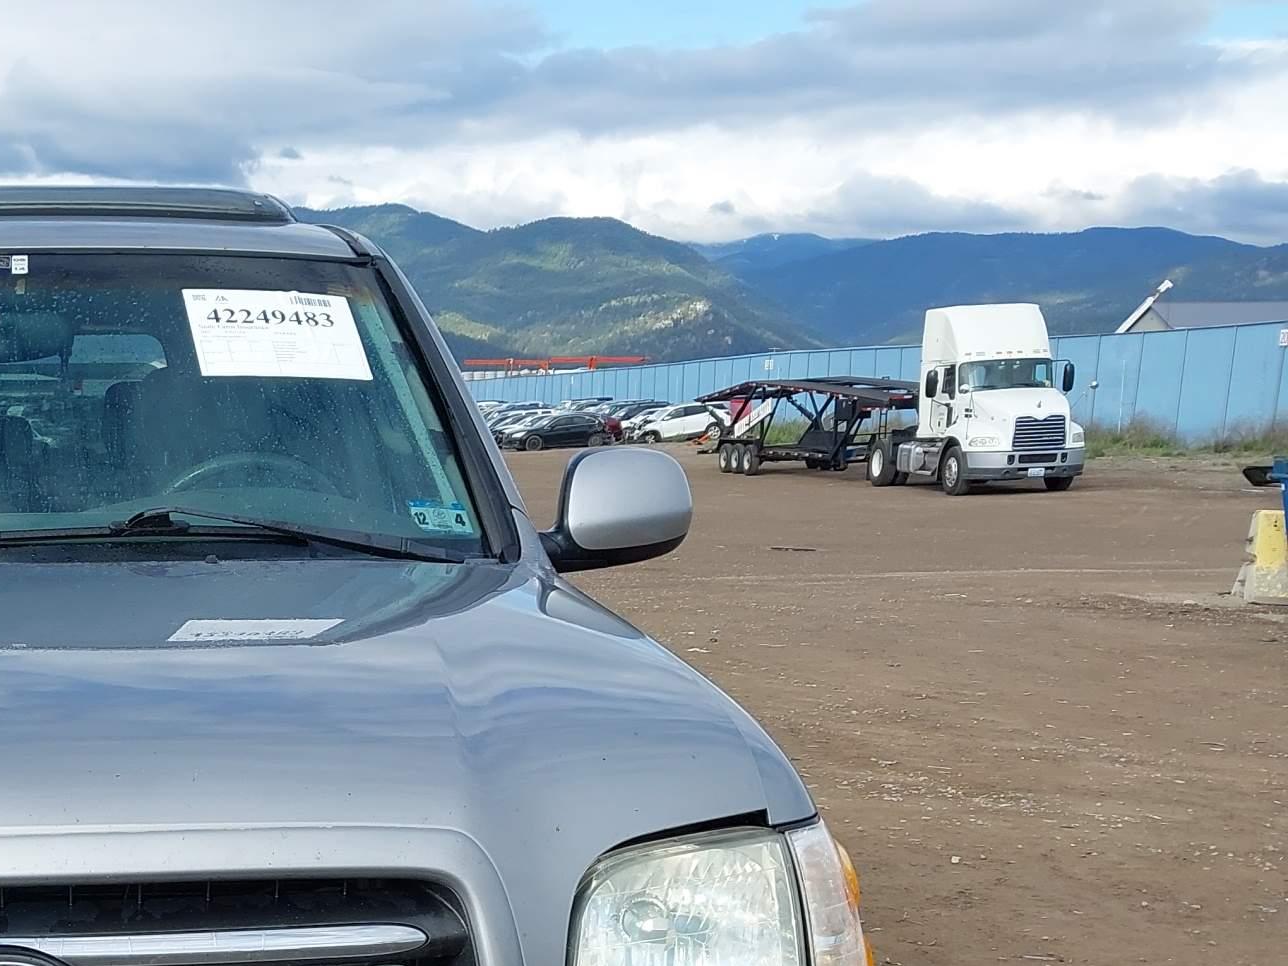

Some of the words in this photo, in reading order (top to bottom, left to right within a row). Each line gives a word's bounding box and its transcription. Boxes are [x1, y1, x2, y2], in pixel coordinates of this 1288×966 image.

[206, 307, 335, 328] 42249483
[413, 511, 429, 526] 12
[455, 513, 466, 527] 4
